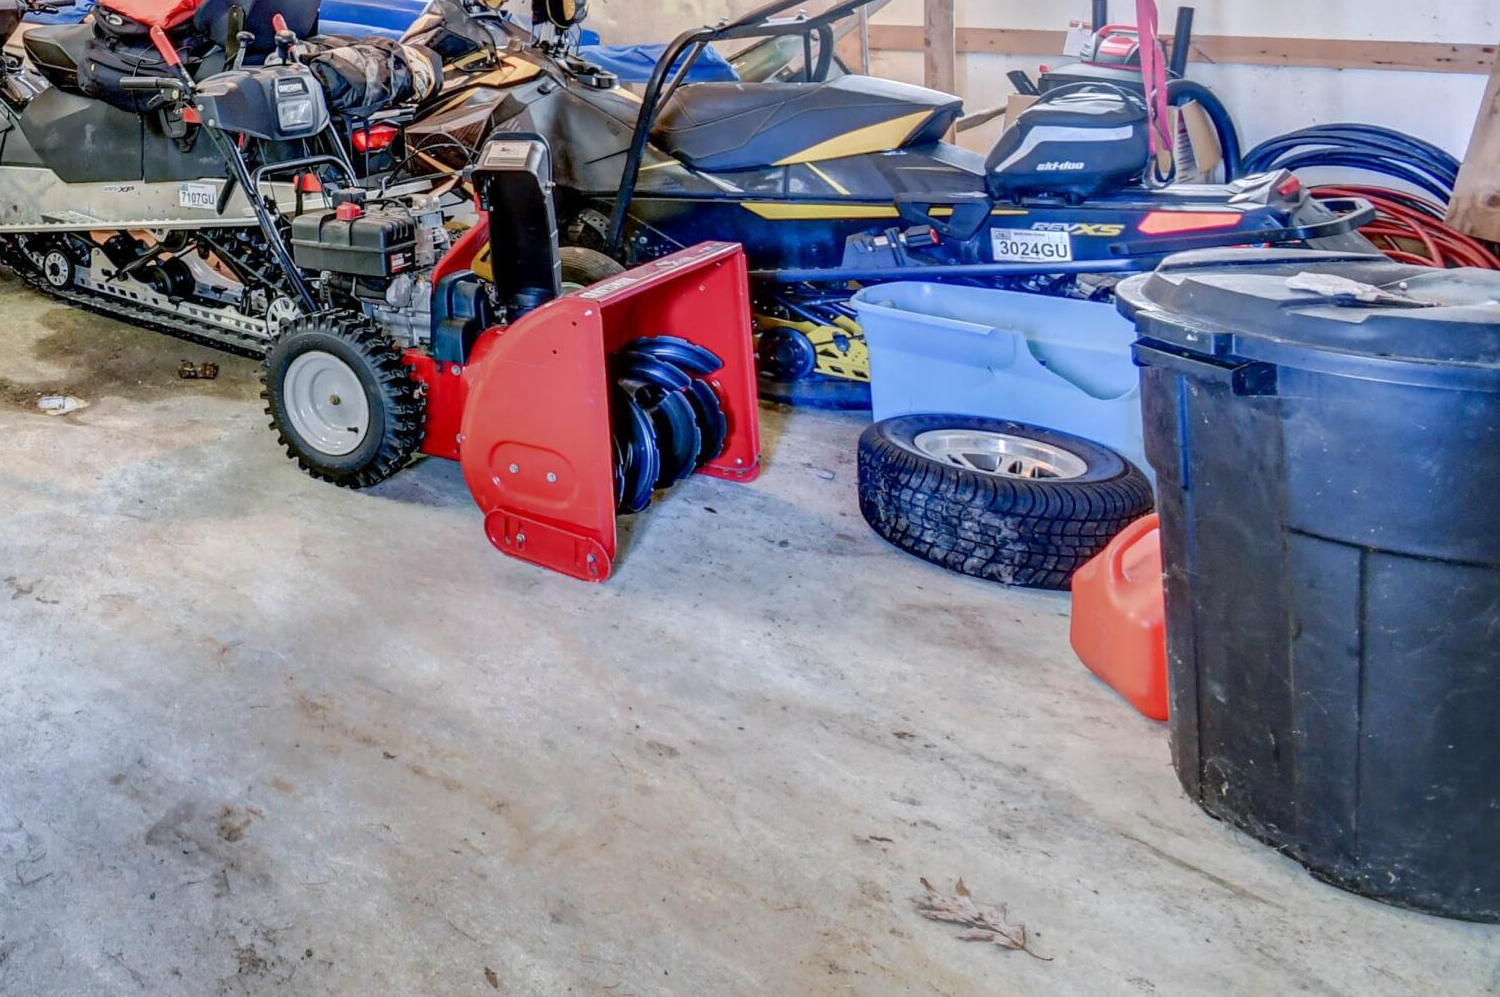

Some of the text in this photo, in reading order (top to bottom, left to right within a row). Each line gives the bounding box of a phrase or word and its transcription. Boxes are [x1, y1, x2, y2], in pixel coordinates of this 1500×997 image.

[1036, 161, 1085, 171] ski-doo
[181, 192, 215, 205] 7107GU
[1000, 241, 1068, 258] 3024GU
